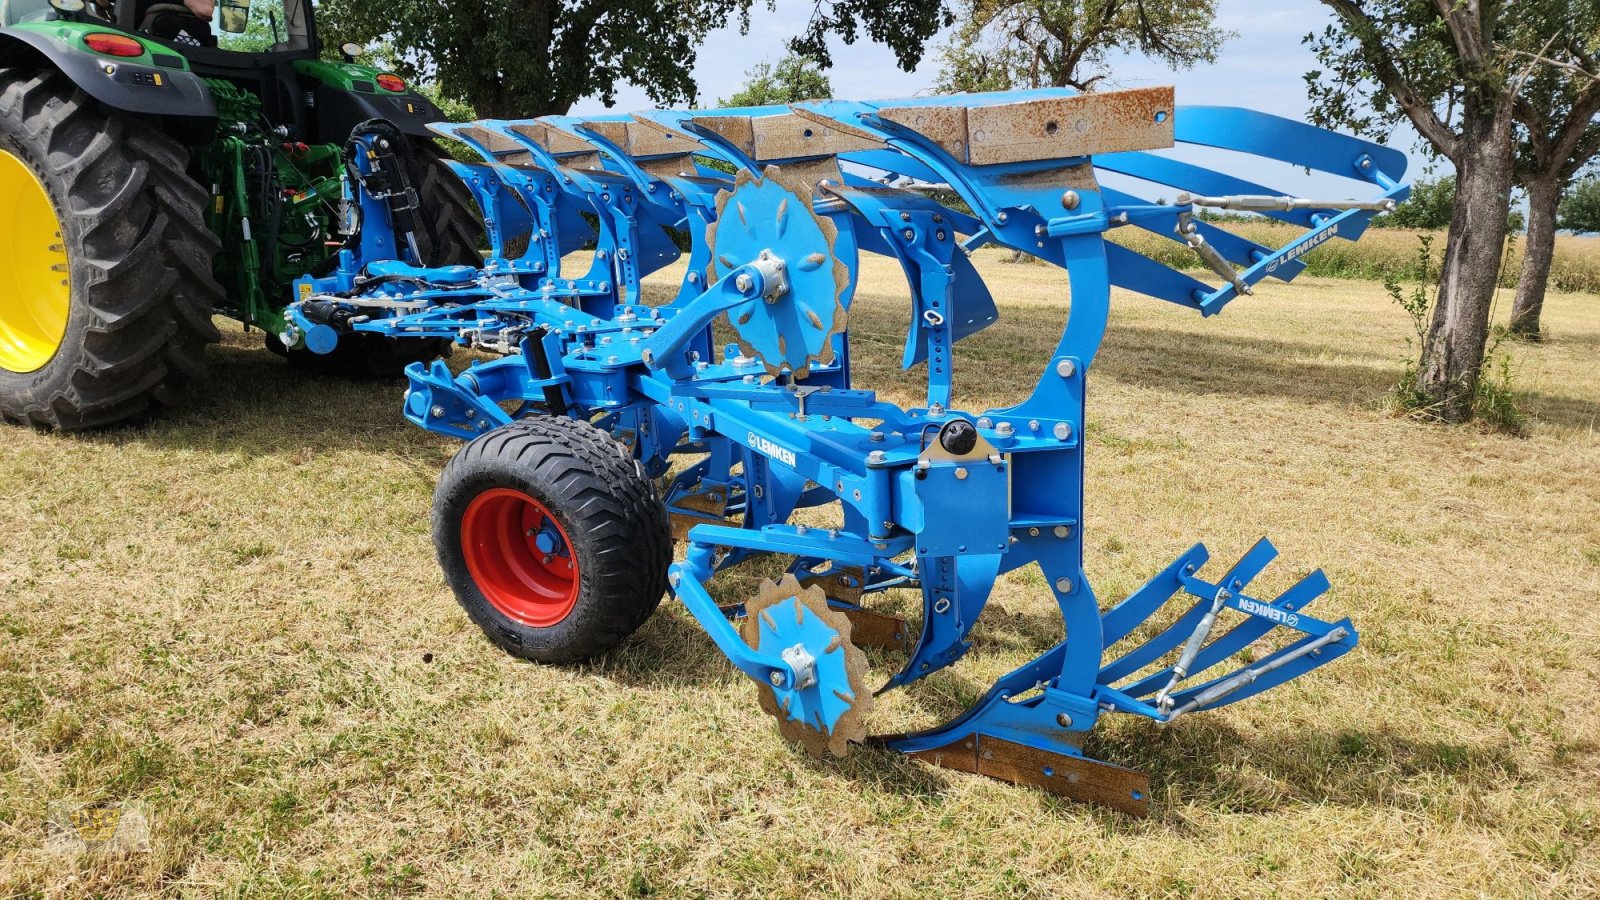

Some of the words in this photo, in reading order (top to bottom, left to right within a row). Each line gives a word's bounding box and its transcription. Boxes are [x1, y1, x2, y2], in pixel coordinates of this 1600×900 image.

[1280, 224, 1338, 264] LEMKEN
[756, 436, 796, 468] LEMKEN
[1239, 598, 1287, 622] LEMKEN
